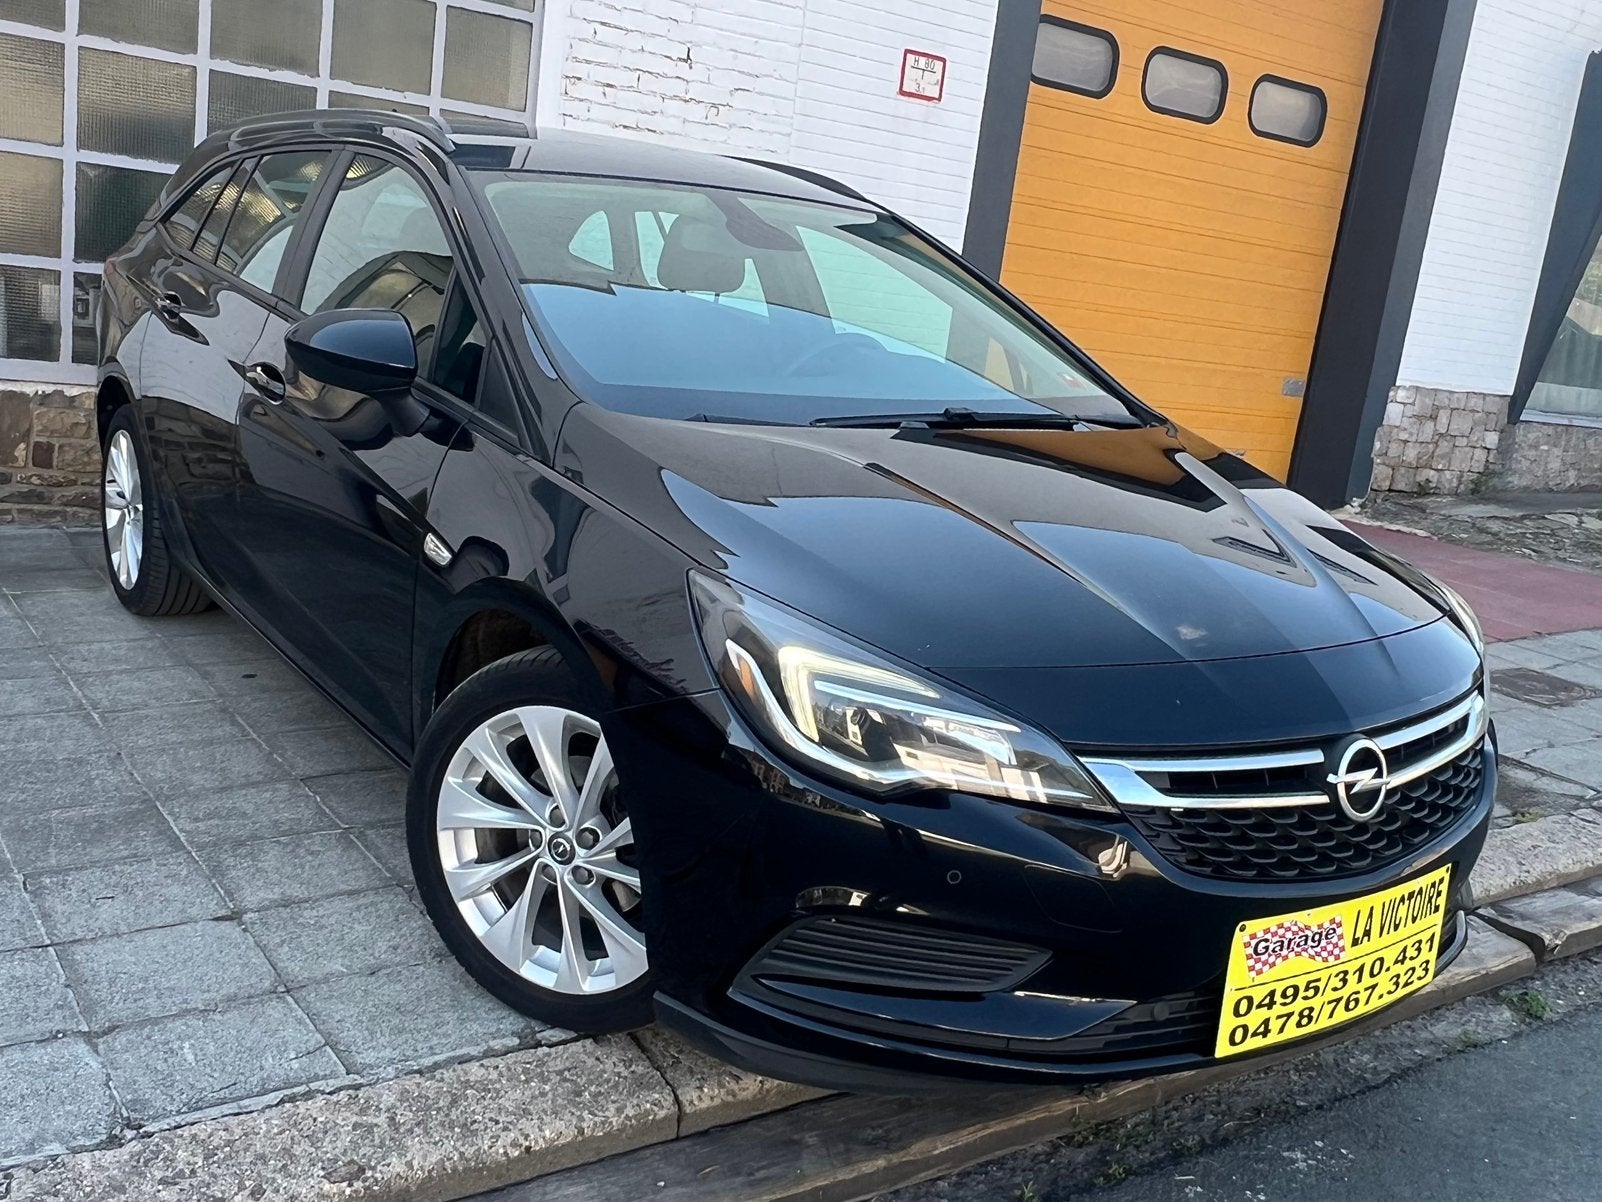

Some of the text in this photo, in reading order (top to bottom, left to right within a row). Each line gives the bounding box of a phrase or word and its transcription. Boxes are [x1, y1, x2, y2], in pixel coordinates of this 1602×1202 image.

[913, 56, 936, 70] H 80
[1252, 876, 1445, 958] Garage LA VICTOIRE
[1228, 959, 1431, 1047] 0478/767.323
[1232, 932, 1436, 1019] 0495/310.431
